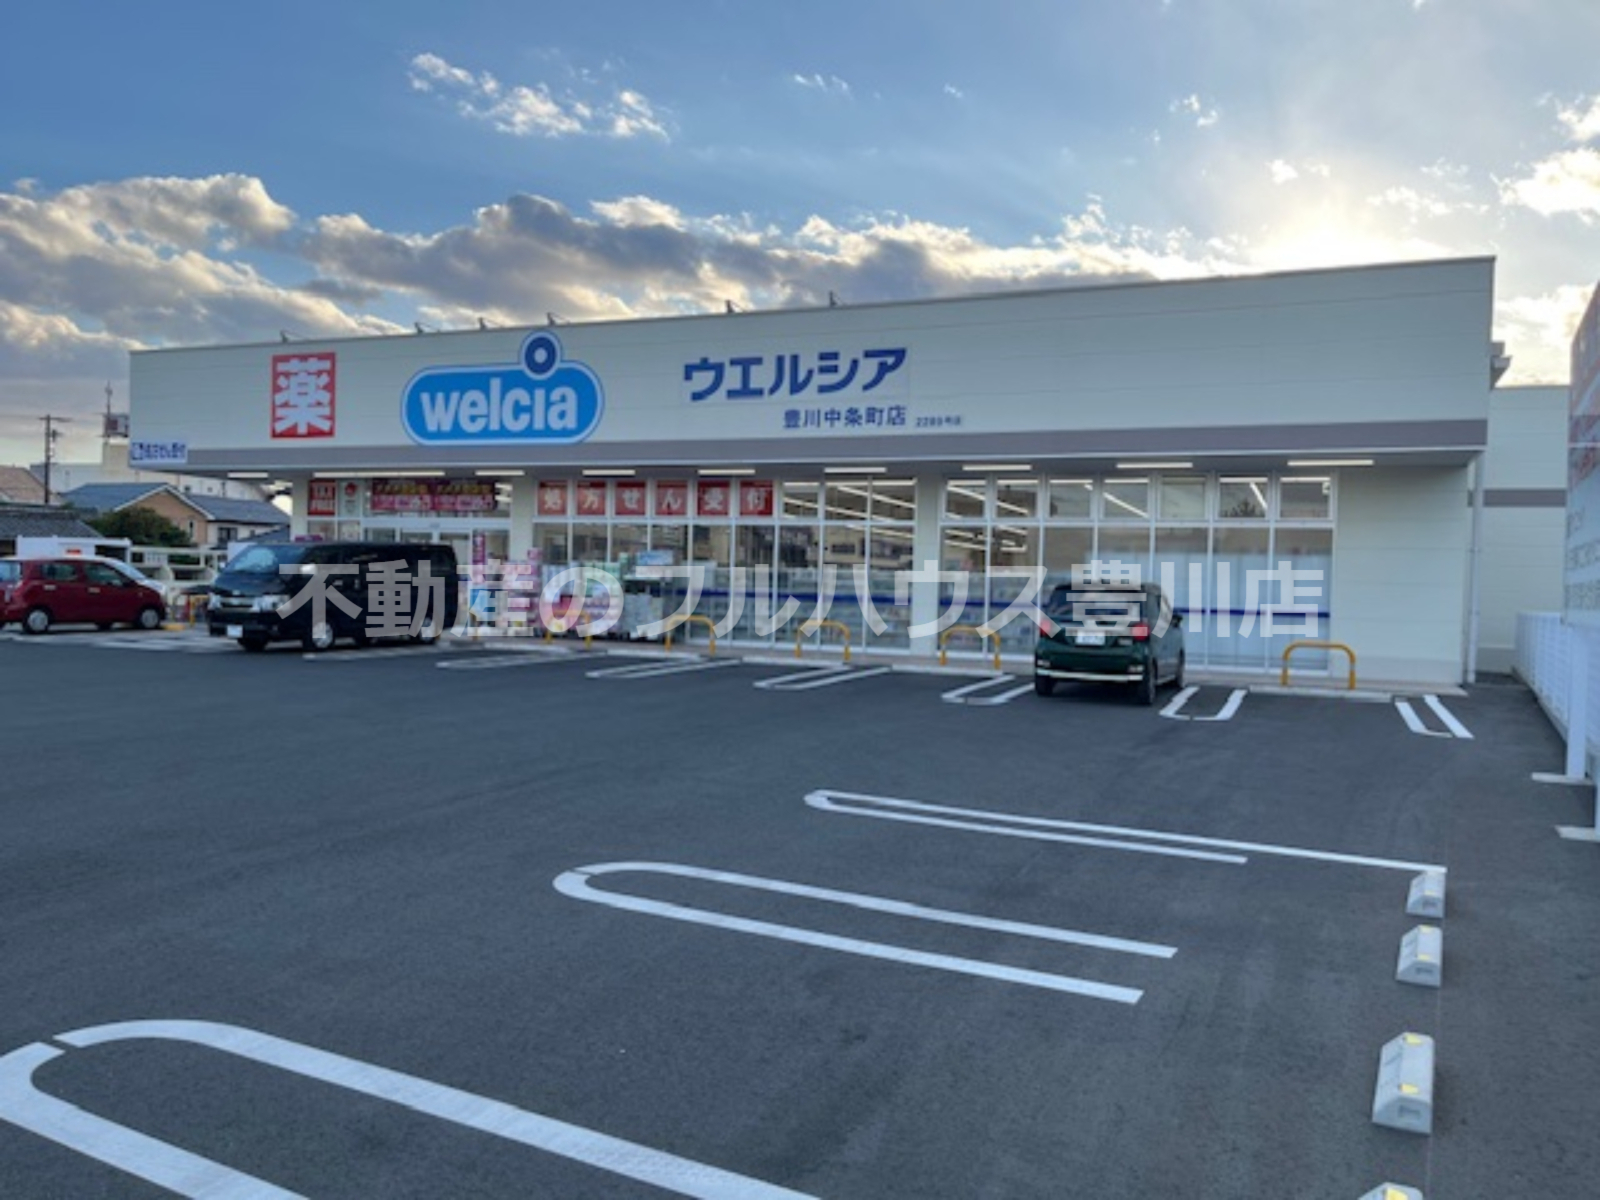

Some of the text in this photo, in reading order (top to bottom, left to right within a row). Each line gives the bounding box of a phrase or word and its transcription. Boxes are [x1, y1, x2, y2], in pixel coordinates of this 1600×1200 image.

[274, 357, 333, 435] 薬
[684, 348, 906, 401] ウエルシア
[420, 377, 578, 433] welcia
[784, 406, 906, 429] 豊川中条町店
[544, 486, 767, 511] 処方せん受付
